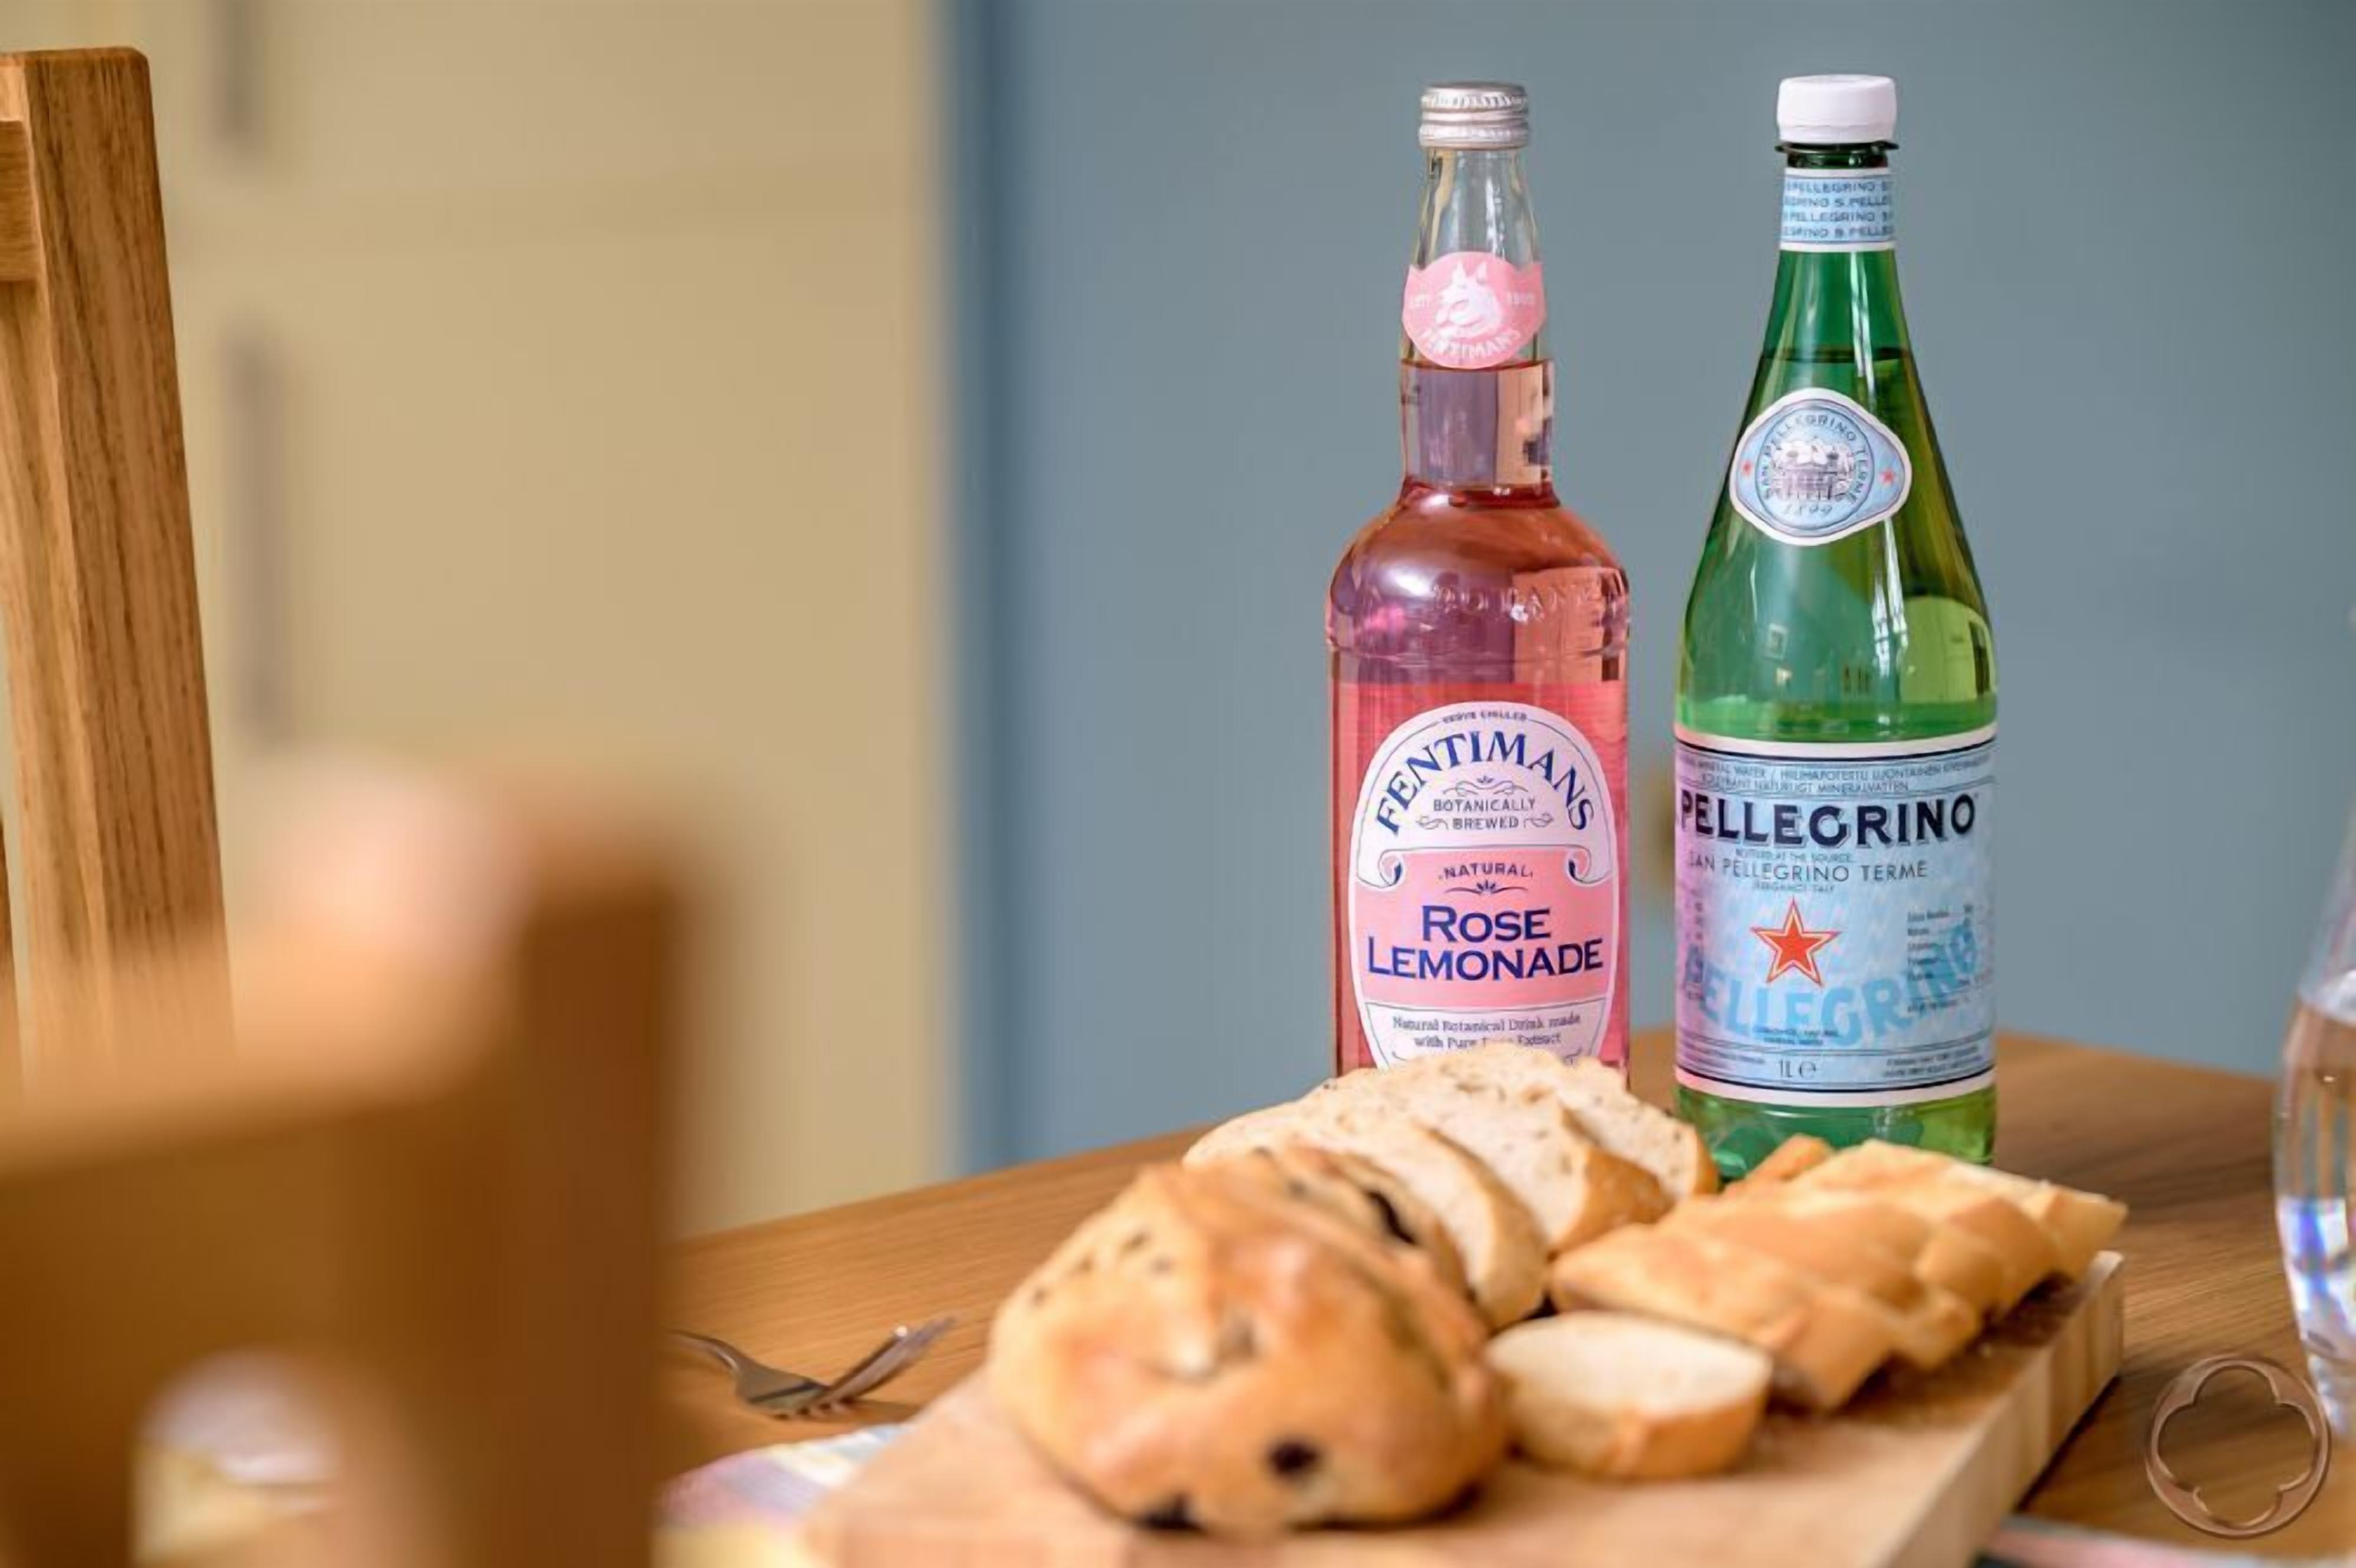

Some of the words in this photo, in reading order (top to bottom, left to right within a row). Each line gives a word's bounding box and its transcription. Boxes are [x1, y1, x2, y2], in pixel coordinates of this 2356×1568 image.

[1376, 730, 1595, 837] FENTIMANS
[1433, 798, 1535, 812] BOTANICALLY
[1453, 816, 1519, 830] BREWED
[1681, 788, 1976, 846] PELLEGRINO
[1723, 858, 1850, 882] PELLEGRINO
[1861, 860, 1928, 882] TERME
[1393, 1015, 1439, 1031] Natural
[1442, 1019, 1505, 1031] Botanical
[1508, 1017, 1544, 1031] Drink
